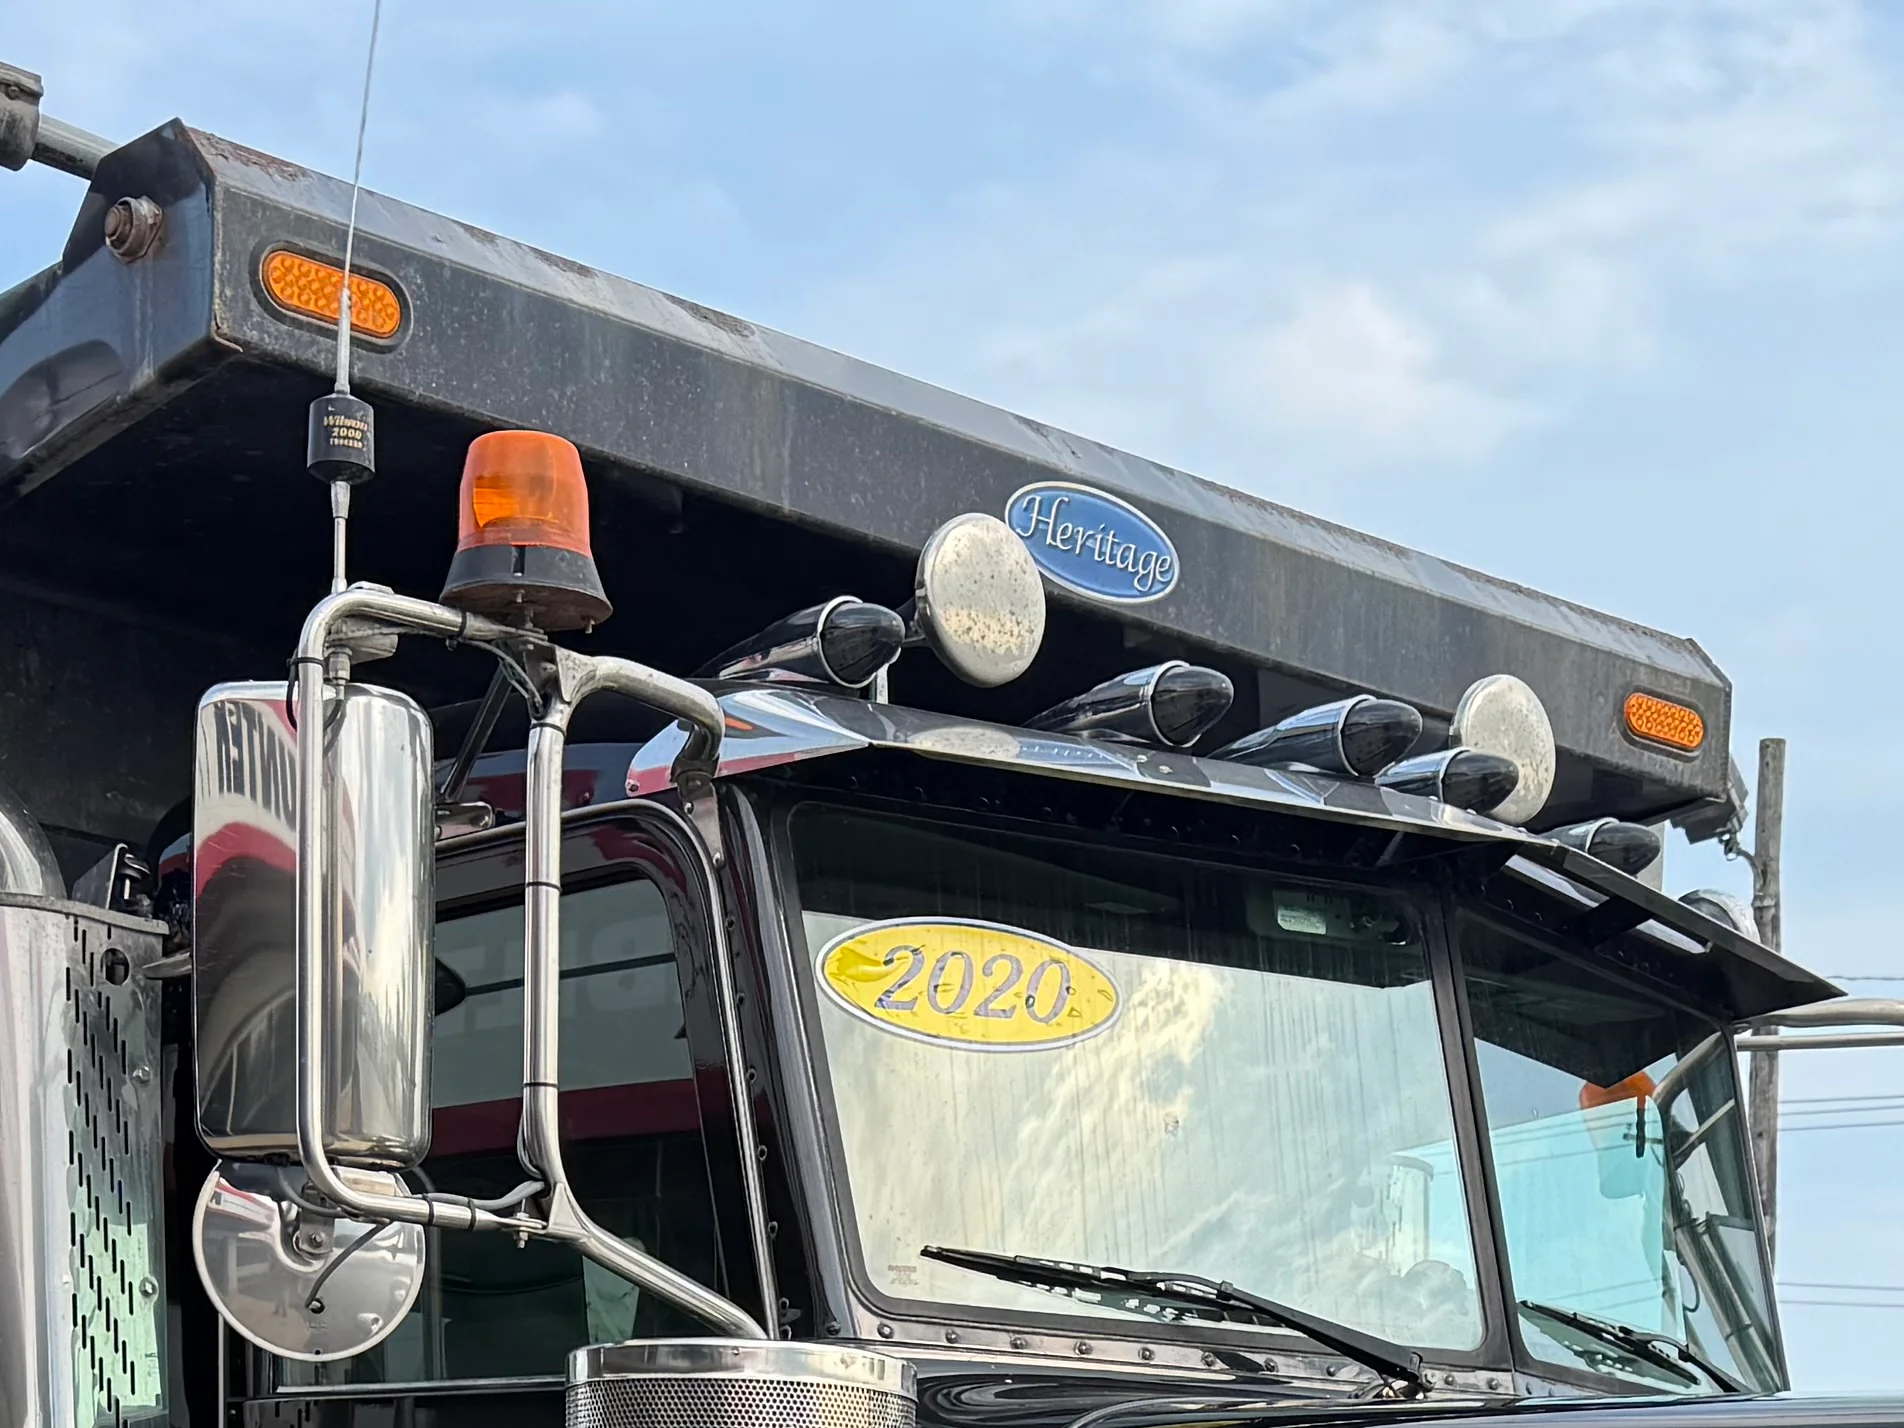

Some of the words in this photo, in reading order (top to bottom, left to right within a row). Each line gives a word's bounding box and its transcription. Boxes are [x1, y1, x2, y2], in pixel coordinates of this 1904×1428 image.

[332, 427, 362, 439] 2000
[1015, 494, 1172, 592] Heritage
[874, 943, 1071, 1024] 2020
